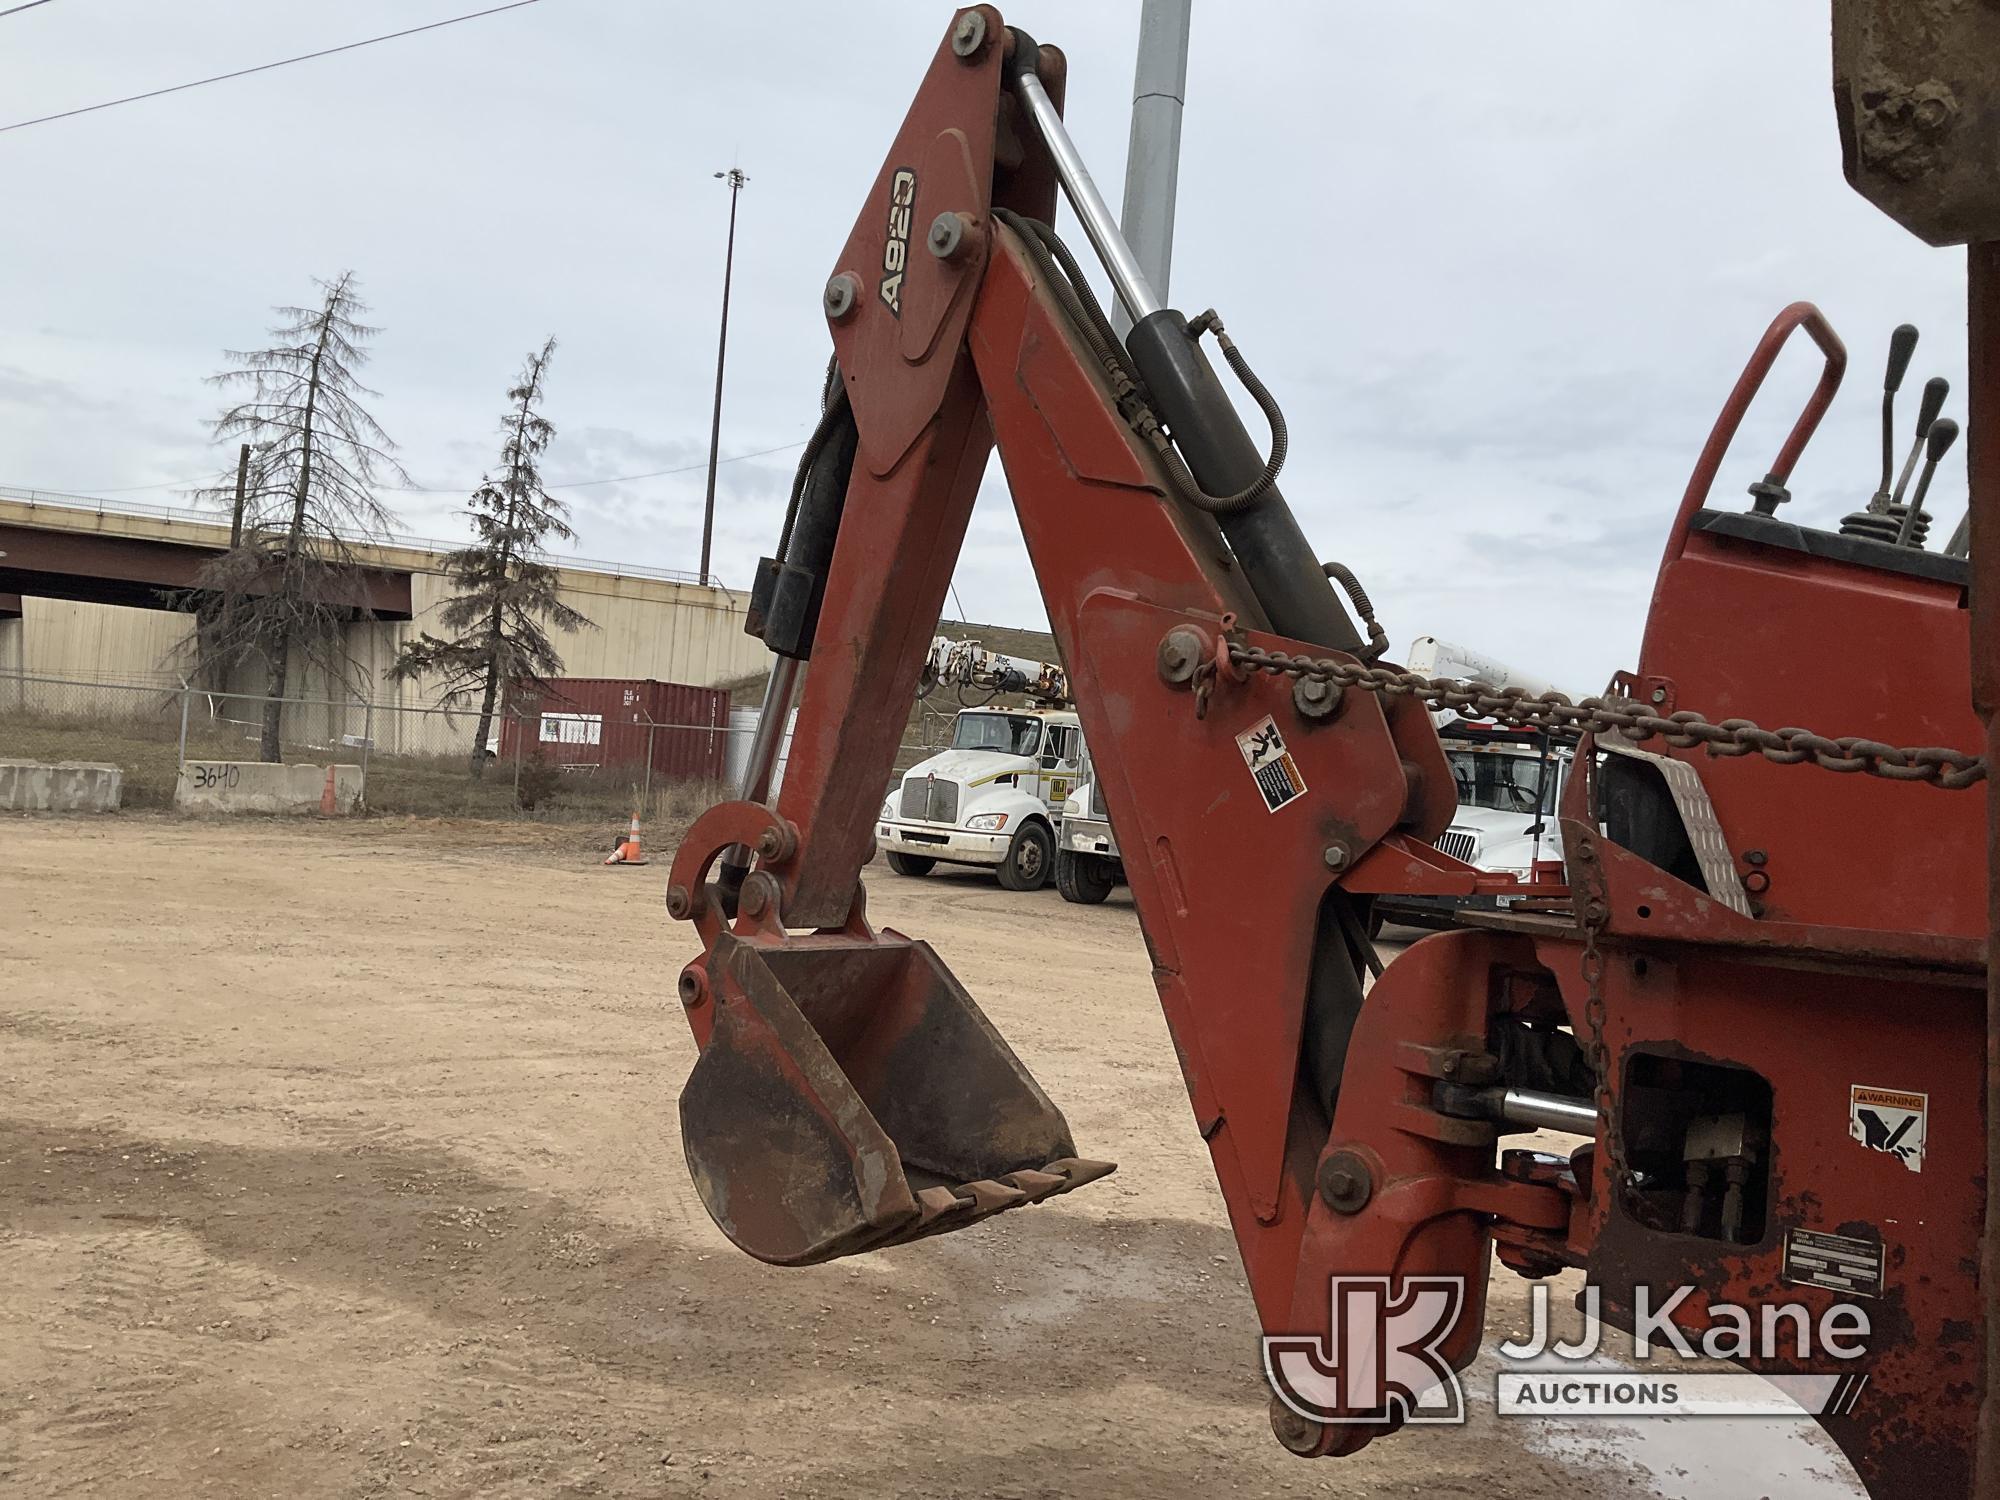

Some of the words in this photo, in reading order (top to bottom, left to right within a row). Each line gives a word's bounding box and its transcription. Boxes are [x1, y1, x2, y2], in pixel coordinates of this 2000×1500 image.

[881, 171, 915, 312] A920
[194, 764, 240, 788] 3640
[1868, 1093, 1921, 1107] WARNING
